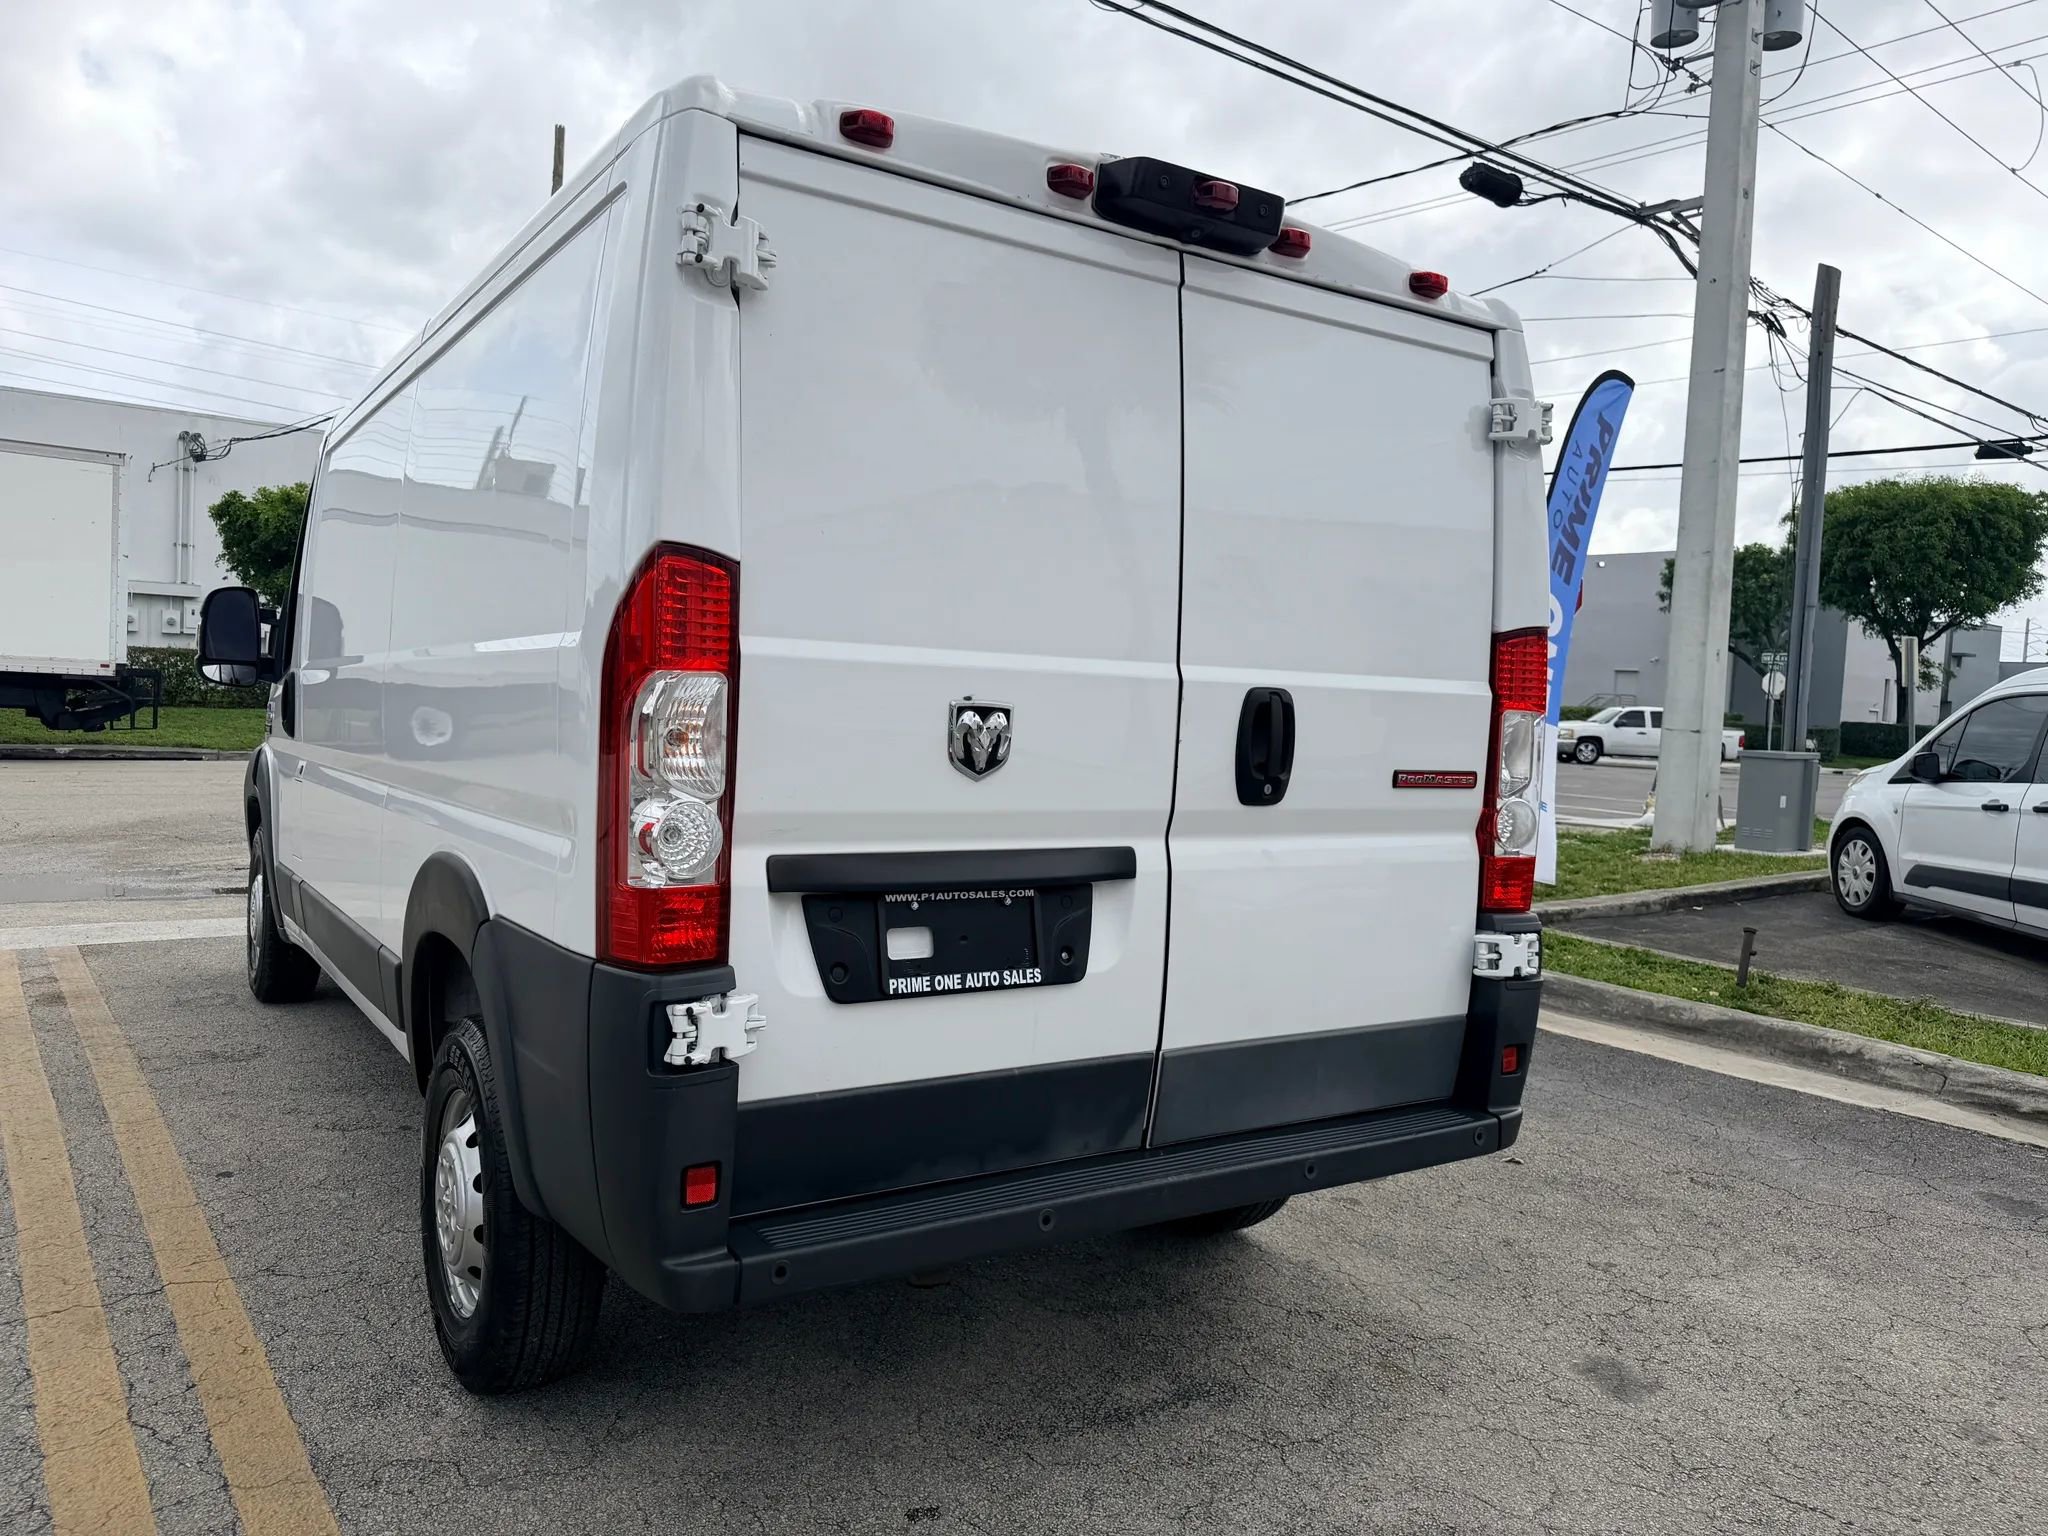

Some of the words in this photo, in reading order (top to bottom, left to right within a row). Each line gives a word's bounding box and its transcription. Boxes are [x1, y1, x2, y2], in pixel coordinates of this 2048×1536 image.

[1552, 411, 1614, 586] PRIME
[1553, 440, 1584, 528] AUTO
[885, 889, 1035, 902] WWW.P1AUTOSALES.COM
[889, 976, 931, 994] PRIME
[934, 974, 962, 991] ONE
[965, 971, 1000, 988] AUTO
[1003, 968, 1042, 985] SALES
